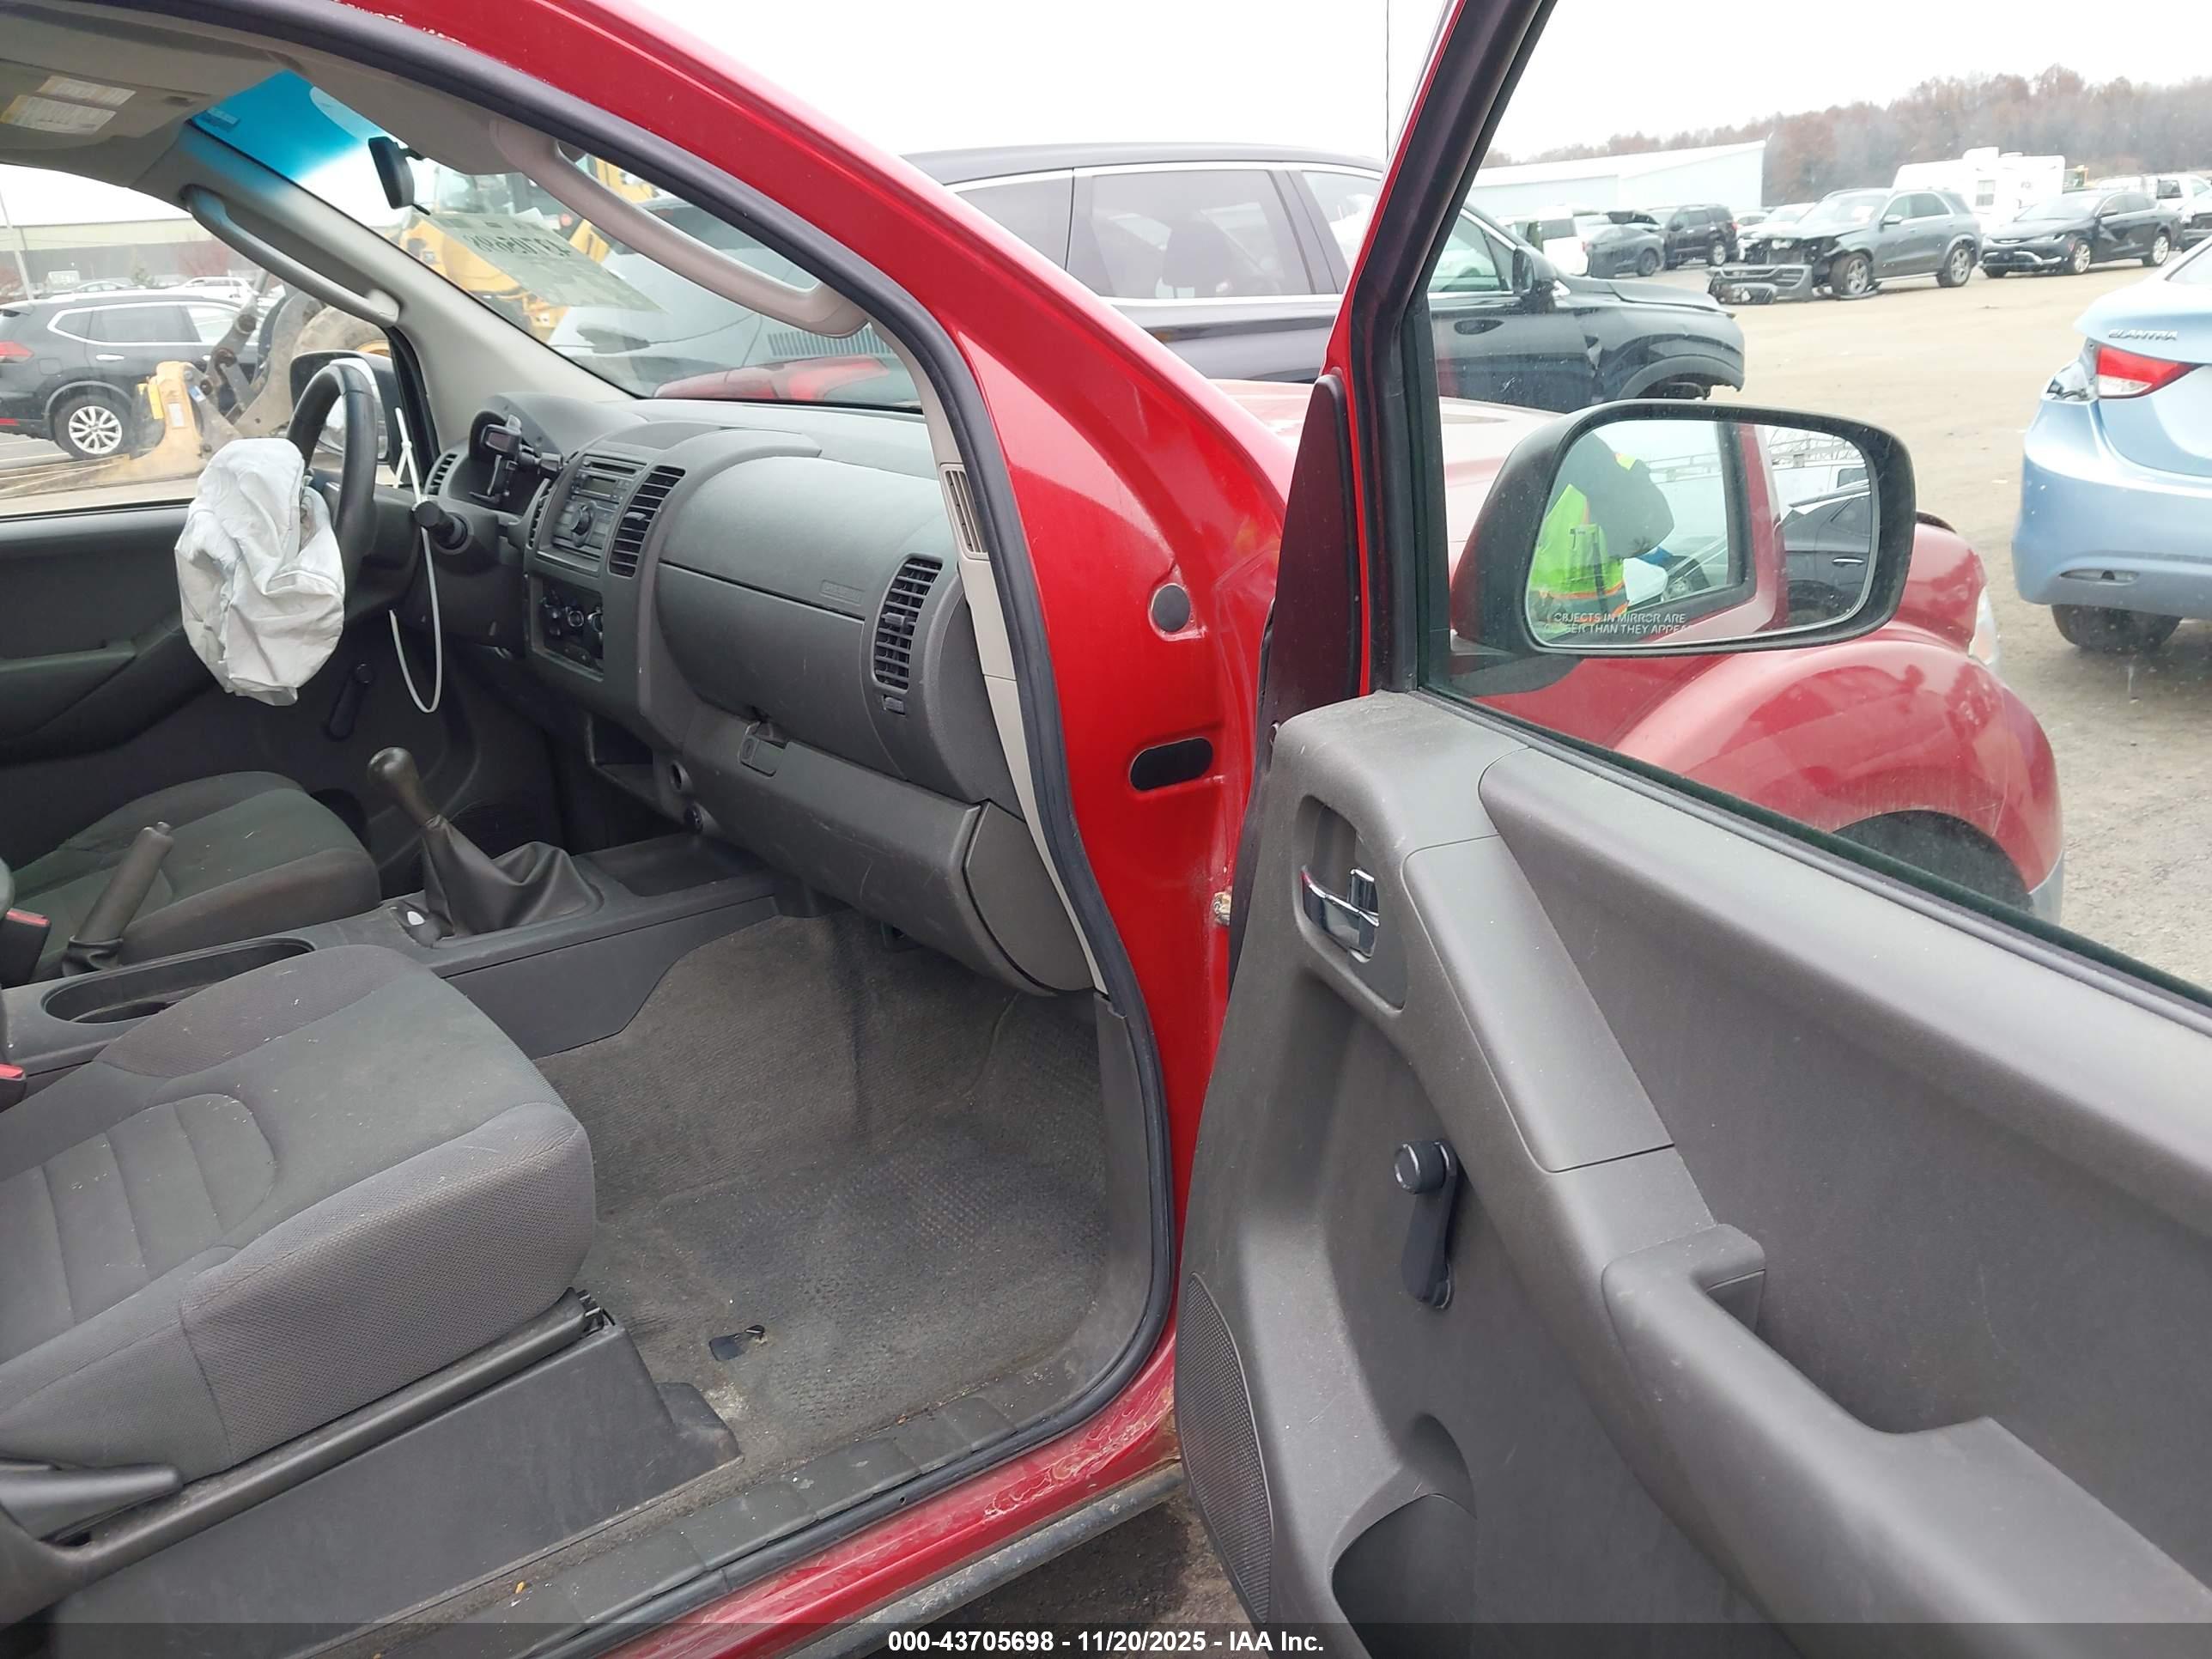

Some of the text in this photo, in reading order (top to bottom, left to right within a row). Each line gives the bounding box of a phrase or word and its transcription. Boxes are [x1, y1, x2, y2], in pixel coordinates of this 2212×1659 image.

[2108, 329, 2179, 341] ELANTRA
[1554, 612, 1686, 624] OBJECTS IN MIRROR ARE
[1589, 623, 1618, 634] THAN
[1620, 623, 1649, 635] THEY
[1650, 623, 1689, 635] APPEA
